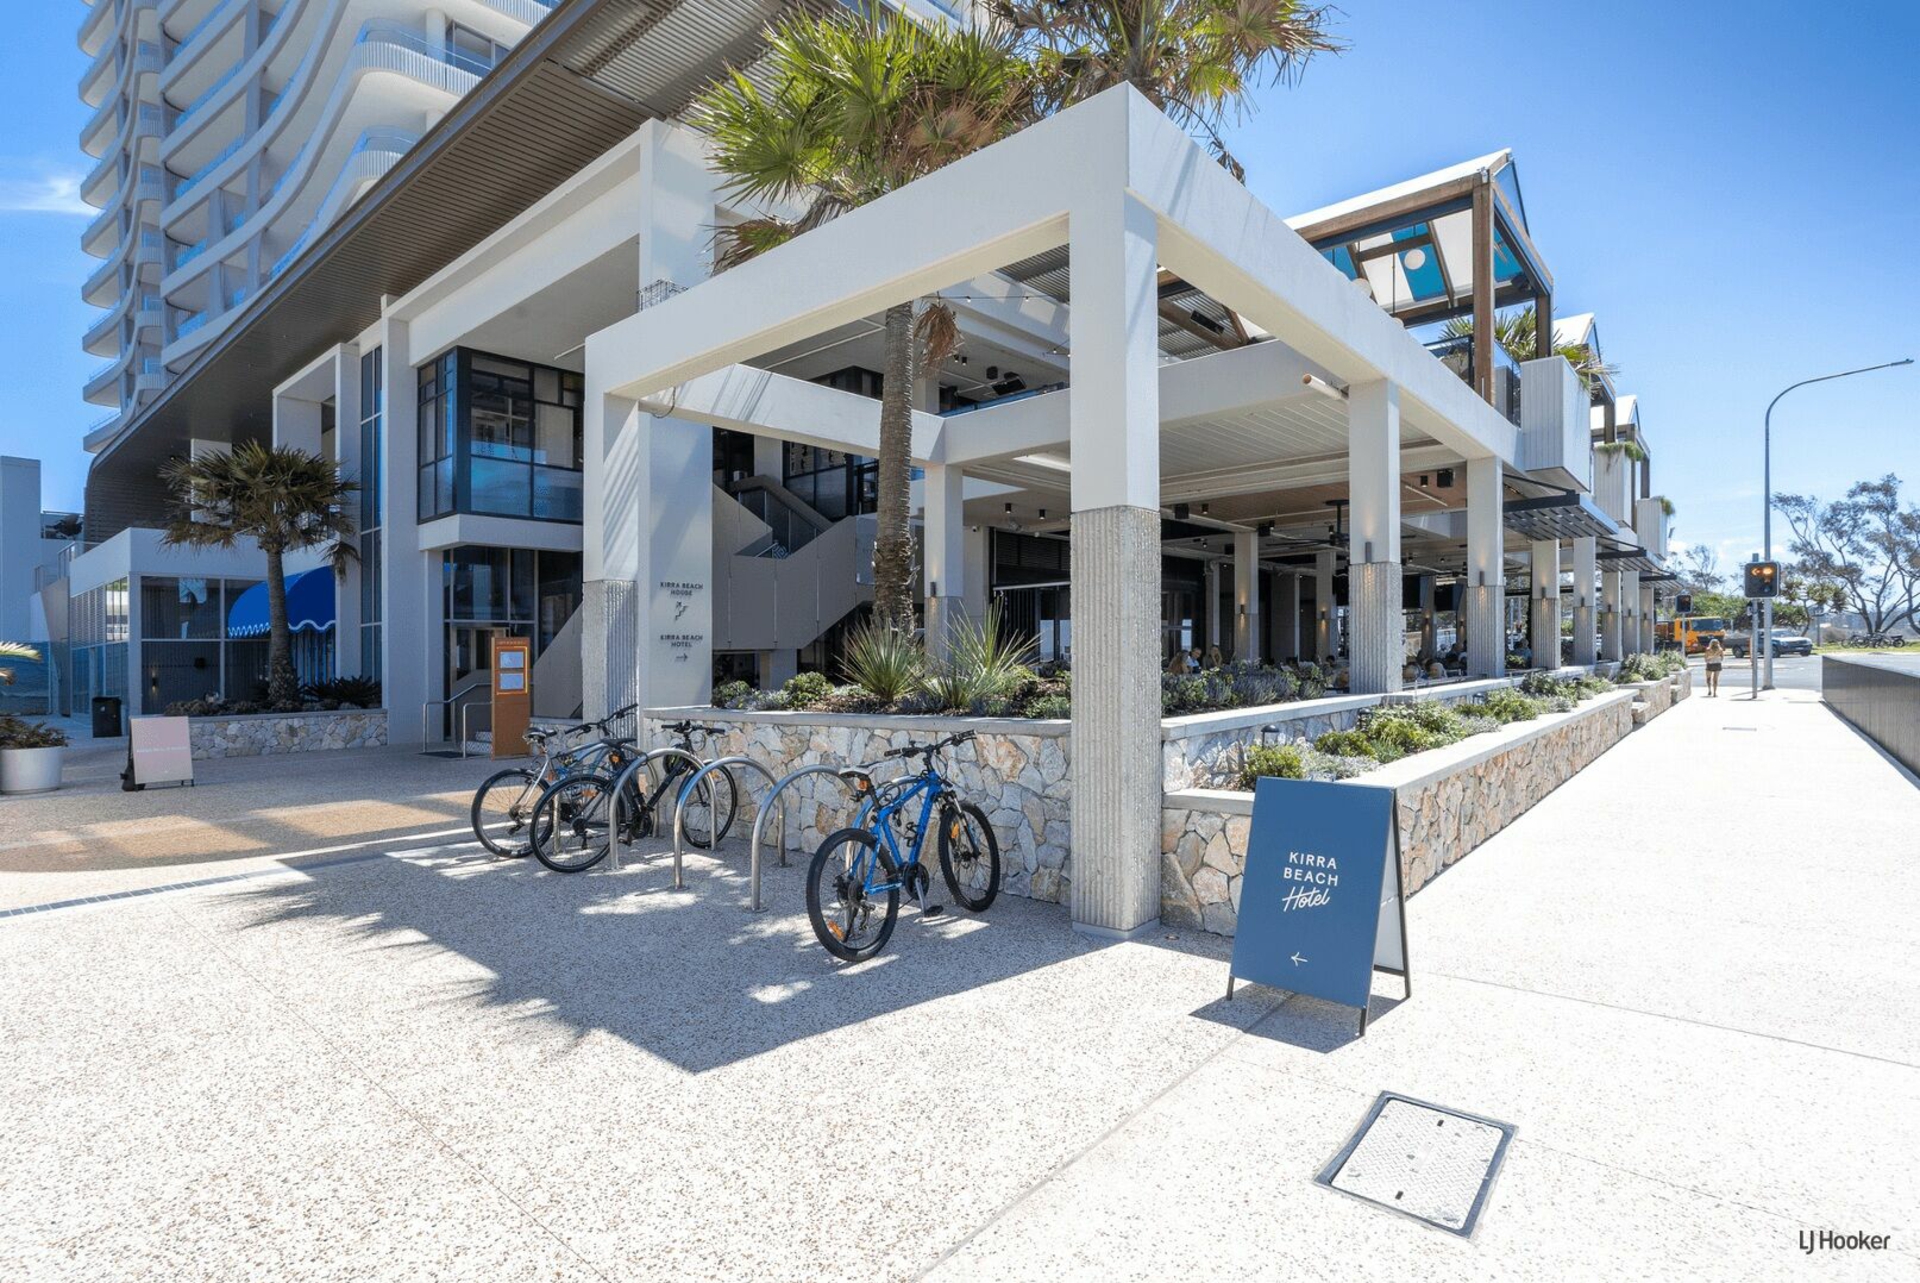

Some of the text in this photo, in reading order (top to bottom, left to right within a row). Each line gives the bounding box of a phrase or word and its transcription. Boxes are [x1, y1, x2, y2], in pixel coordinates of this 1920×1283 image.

[1289, 851, 1337, 870] KIRRA
[1283, 867, 1339, 887] BEACH
[1282, 886, 1331, 912] Hotel
